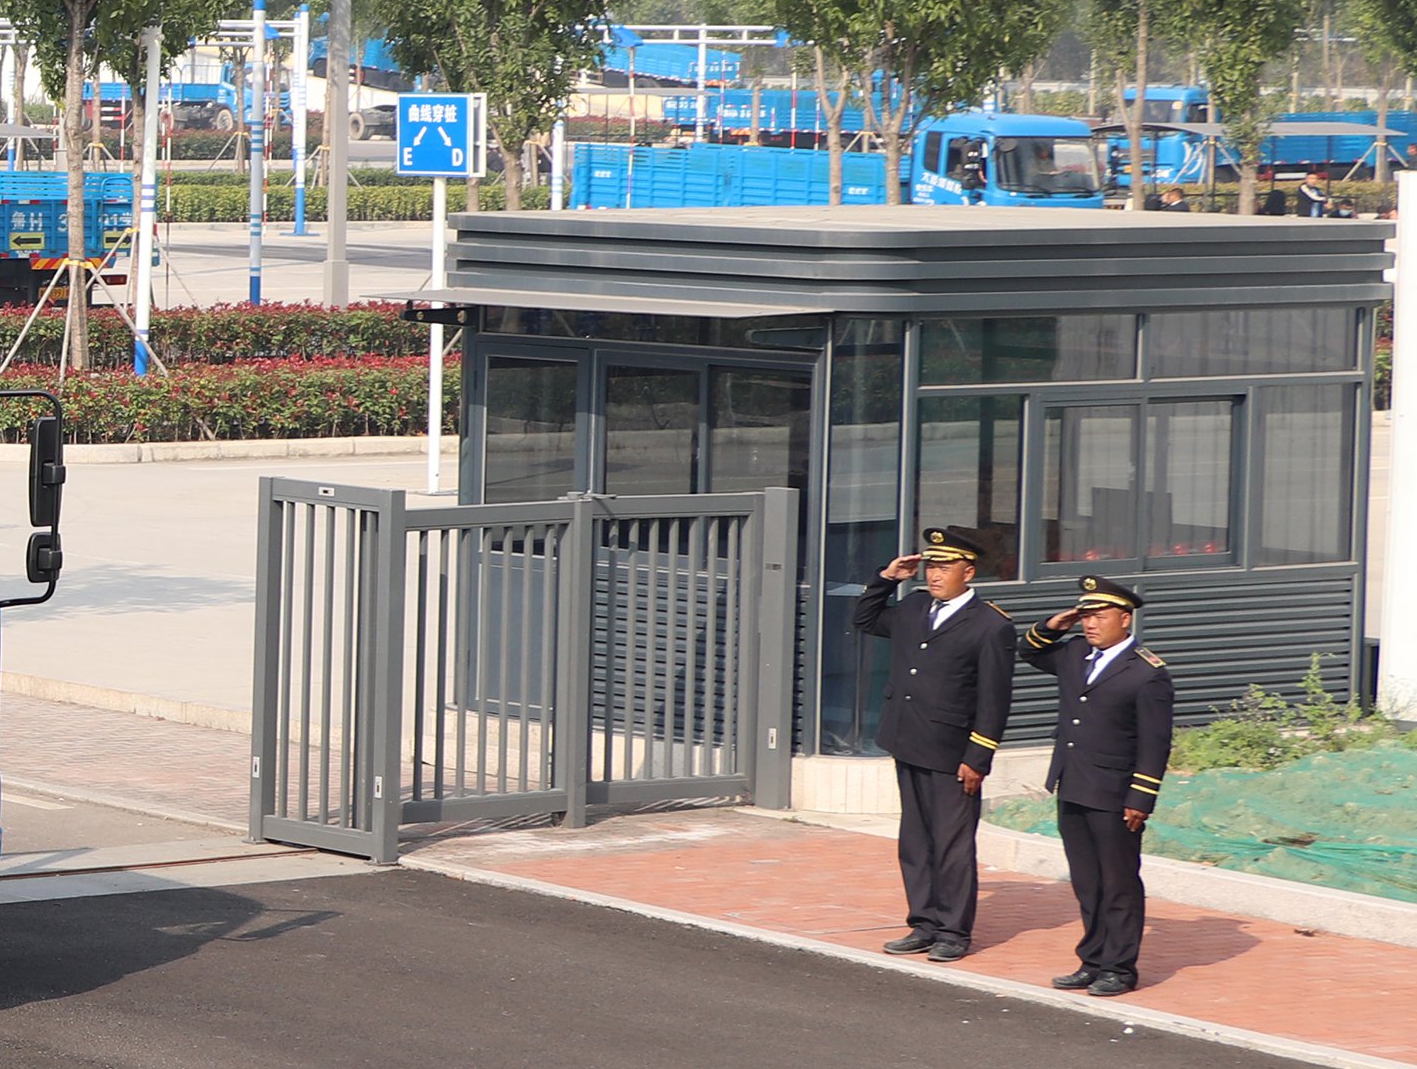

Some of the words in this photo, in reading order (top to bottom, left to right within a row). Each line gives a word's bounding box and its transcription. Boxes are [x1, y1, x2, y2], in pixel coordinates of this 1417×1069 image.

[408, 104, 457, 123] 曲线穿桩
[403, 147, 413, 166] E
[452, 148, 464, 167] D
